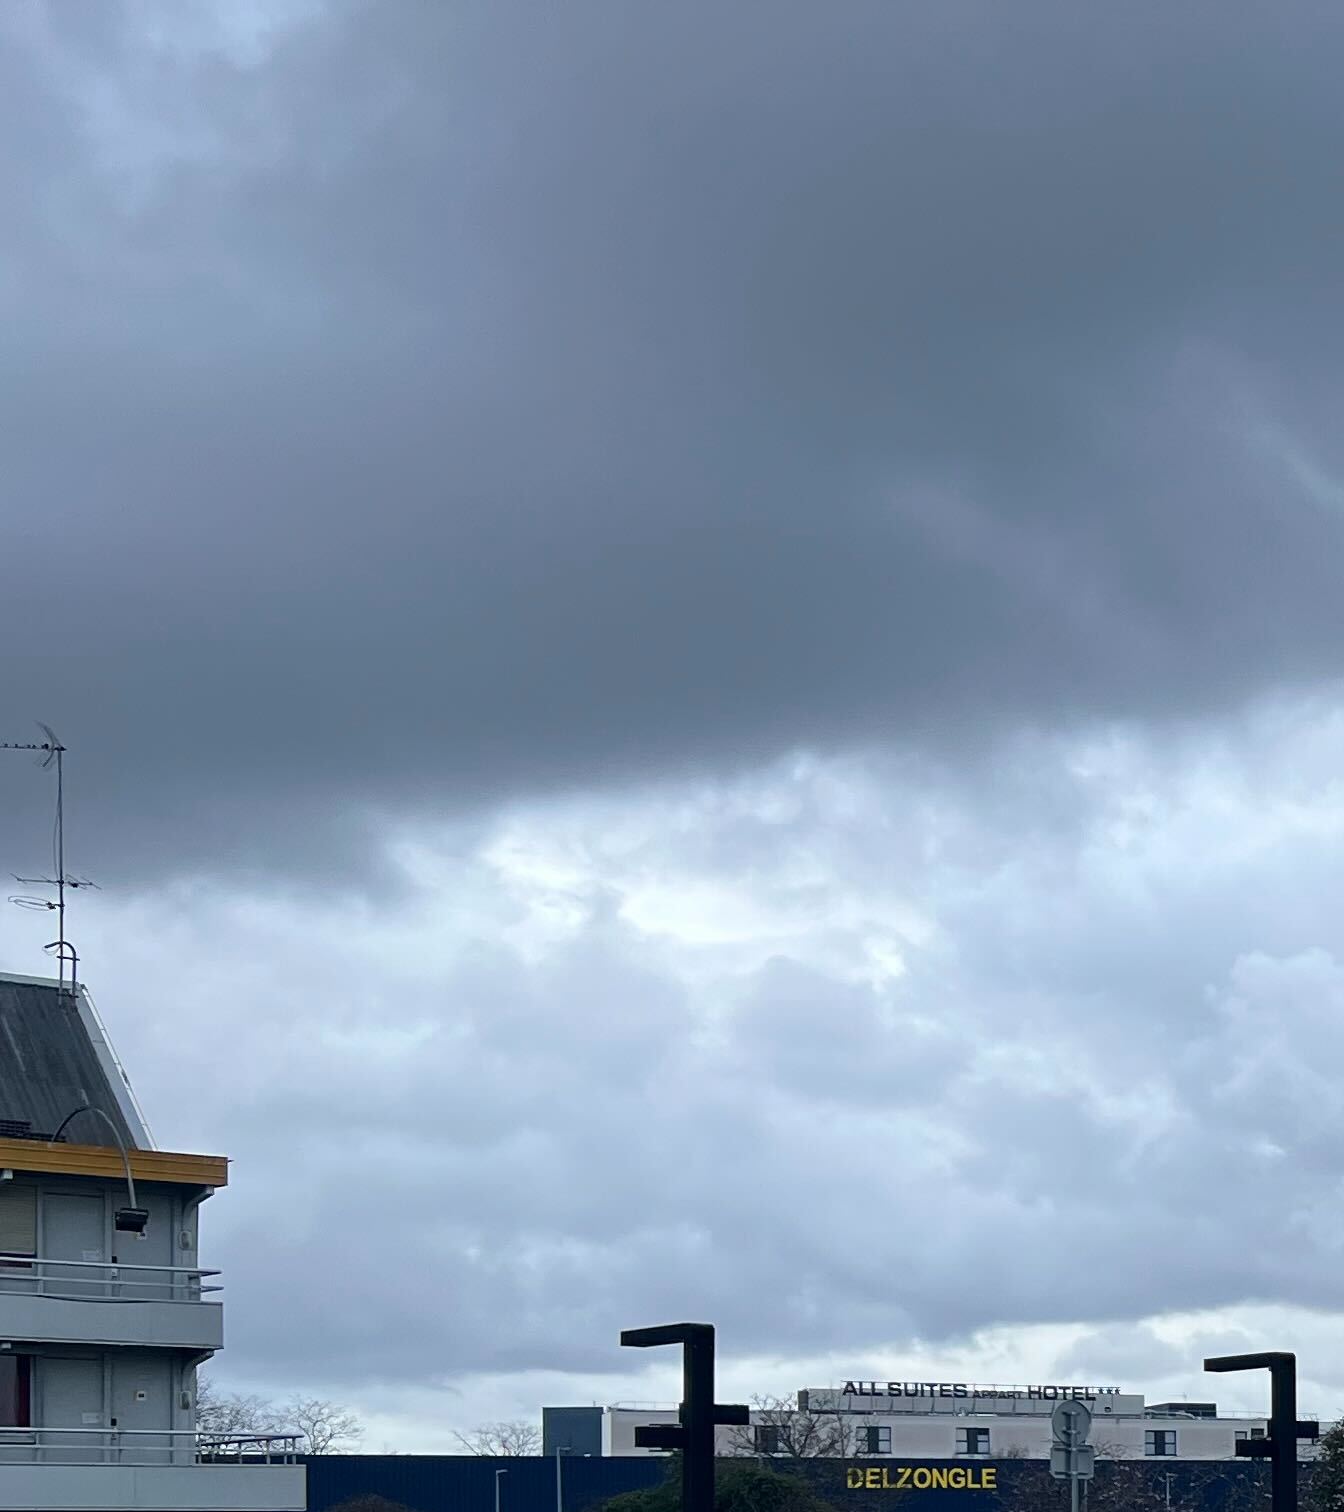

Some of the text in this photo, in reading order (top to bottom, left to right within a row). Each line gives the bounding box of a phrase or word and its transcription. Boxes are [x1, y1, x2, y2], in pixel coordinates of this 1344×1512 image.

[843, 1381, 883, 1397] ALL
[887, 1383, 968, 1399] SUITES
[1028, 1385, 1097, 1401] HOTEL
[847, 1467, 997, 1489] DELZONGLE
